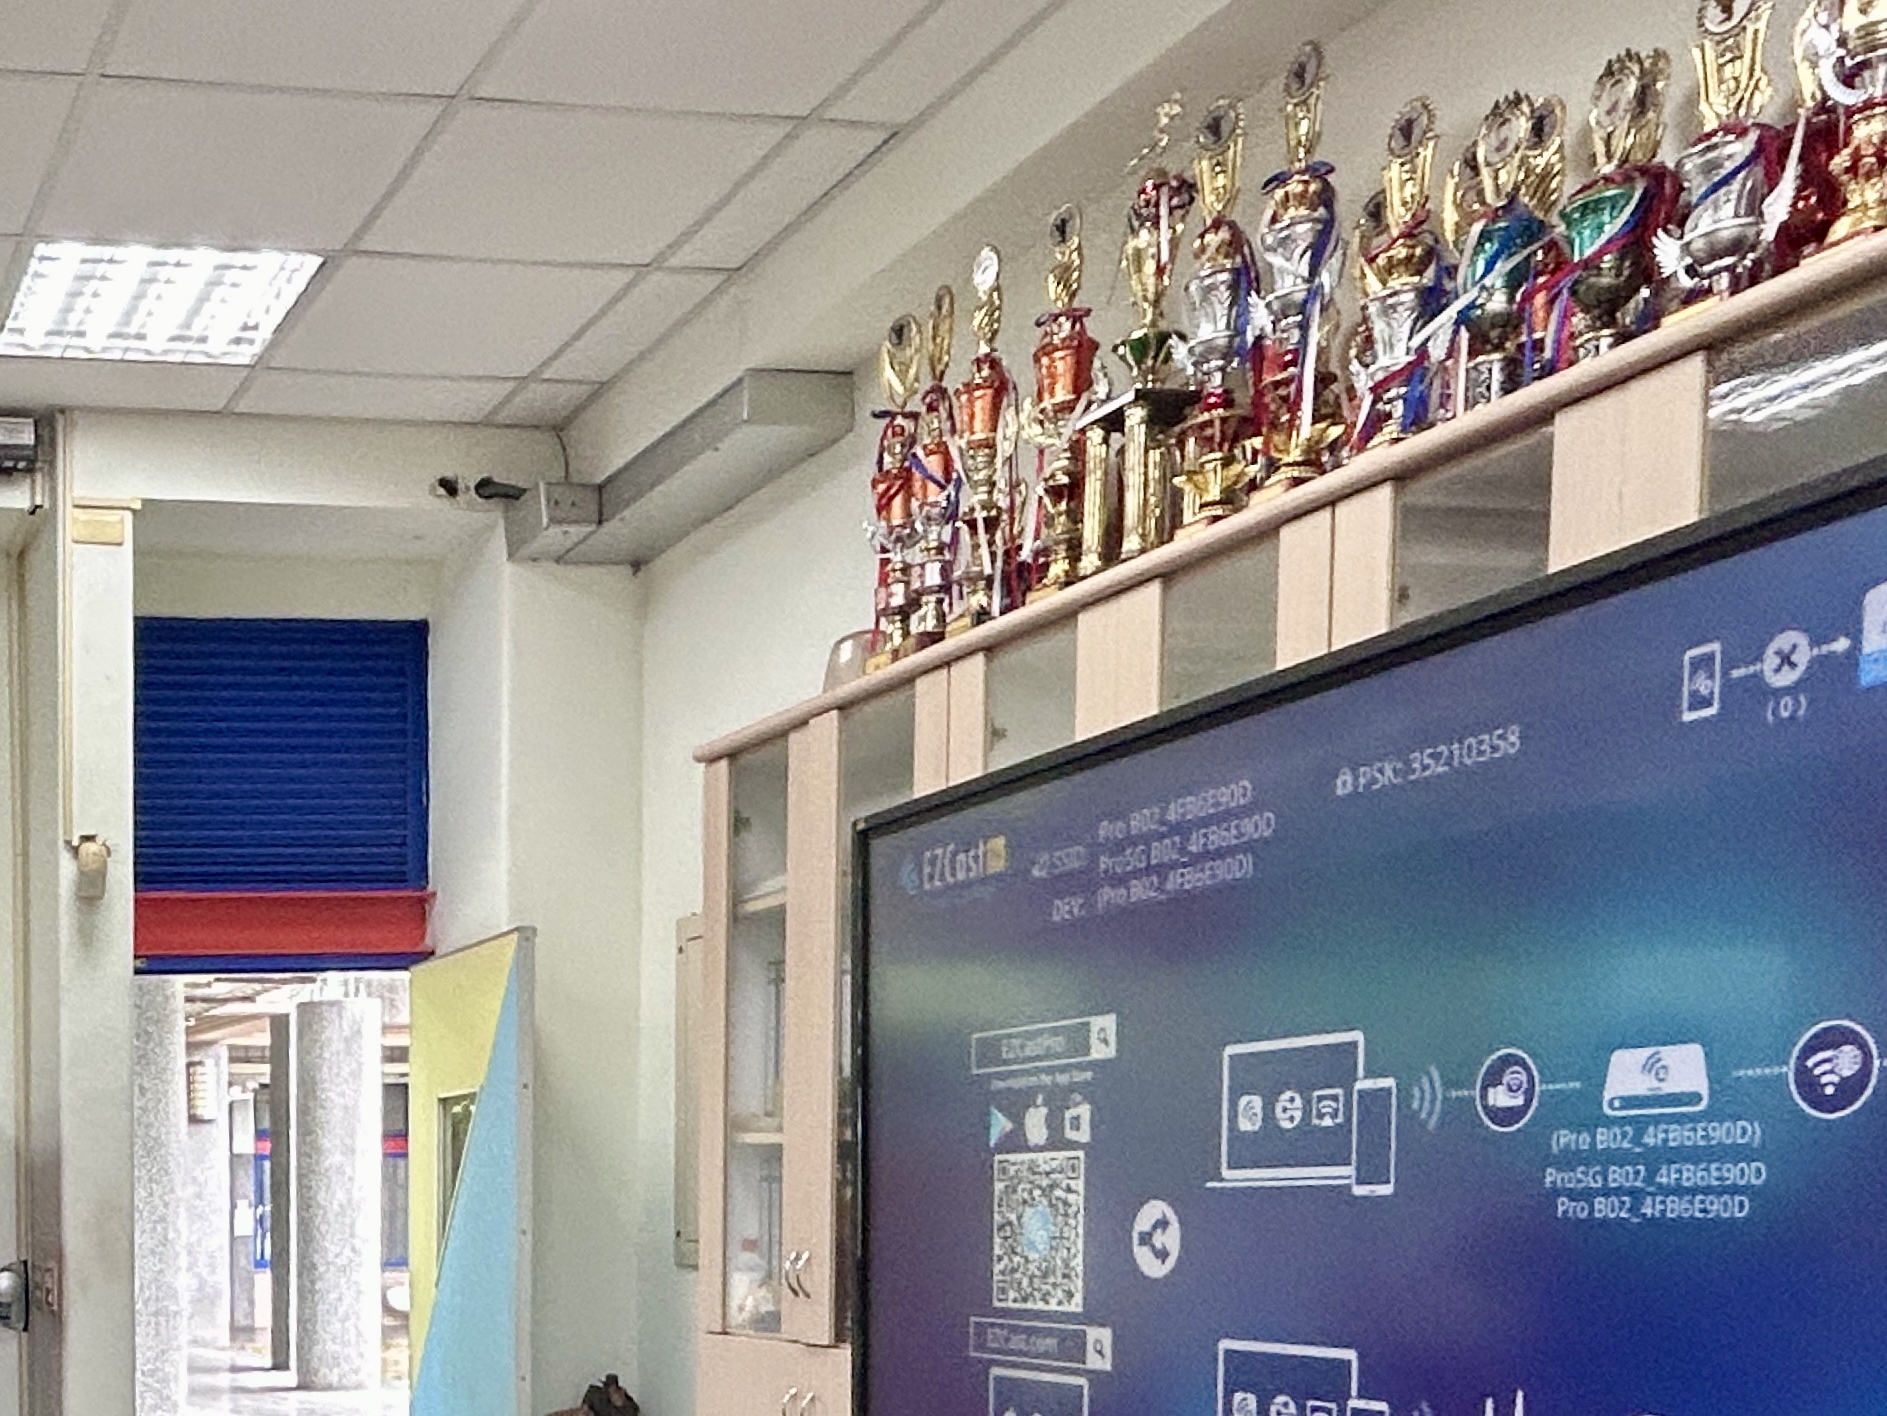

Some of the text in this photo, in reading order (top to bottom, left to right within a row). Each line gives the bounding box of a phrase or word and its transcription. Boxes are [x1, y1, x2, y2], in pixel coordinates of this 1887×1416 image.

[1408, 725, 1520, 780] 35210358
[1551, 1120, 1762, 1153] (Pro B02_4FB6E90D)
[1608, 1161, 1766, 1191] B02_4FB6E90D
[1556, 1194, 1750, 1223] Pro B02_4FB6E90D
